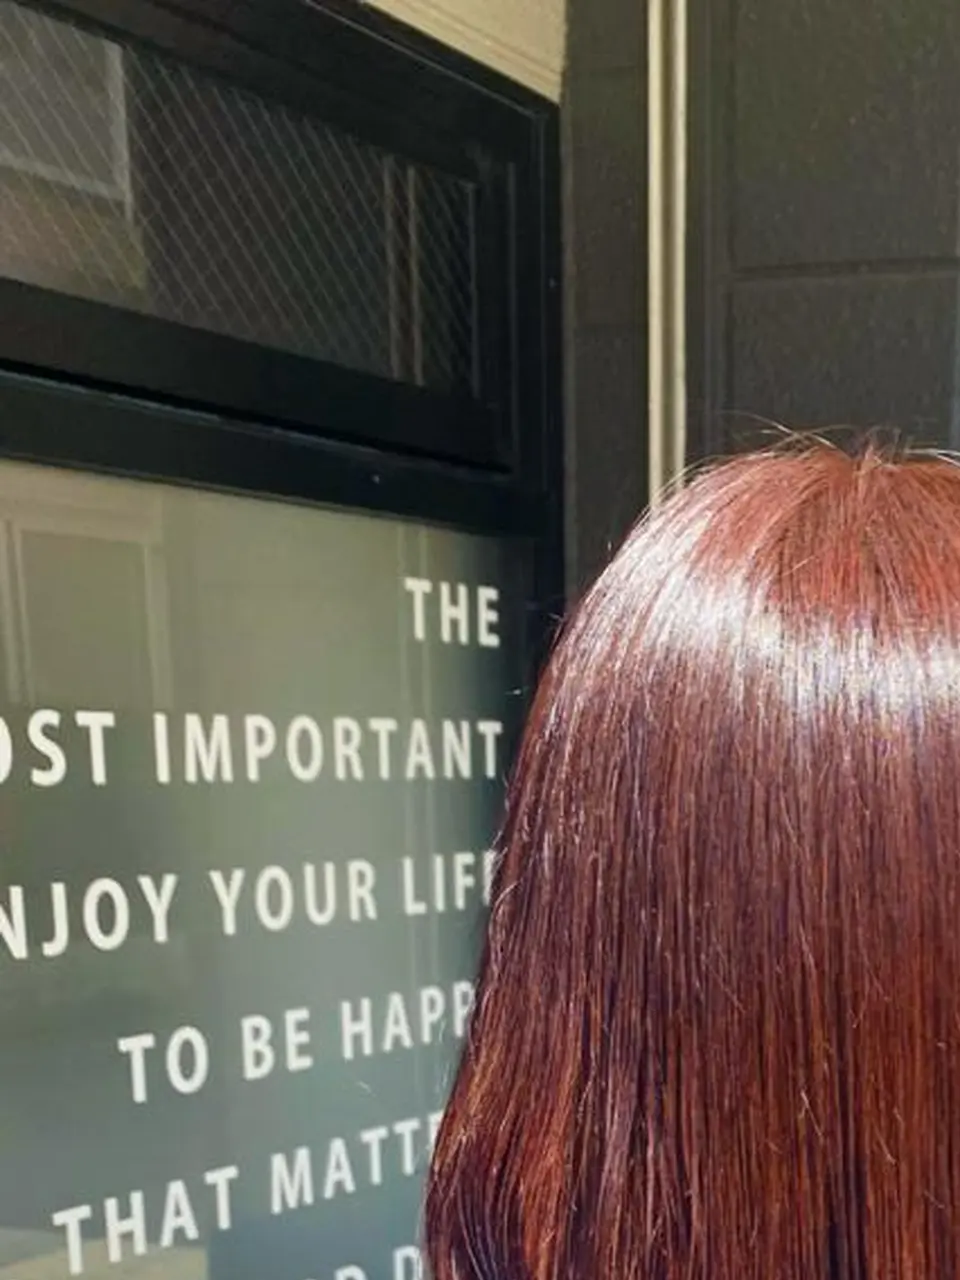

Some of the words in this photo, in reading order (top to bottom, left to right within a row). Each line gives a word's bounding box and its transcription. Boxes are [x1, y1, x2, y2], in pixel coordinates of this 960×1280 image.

[404, 577, 500, 647] THE
[153, 713, 503, 784] IMPORTANT
[0, 873, 178, 960] NJOY
[209, 859, 377, 936] YOUR
[118, 1026, 208, 1102] TO
[241, 1008, 314, 1080] BE
[341, 980, 475, 1060] HAPP
[53, 1165, 239, 1275] THAT
